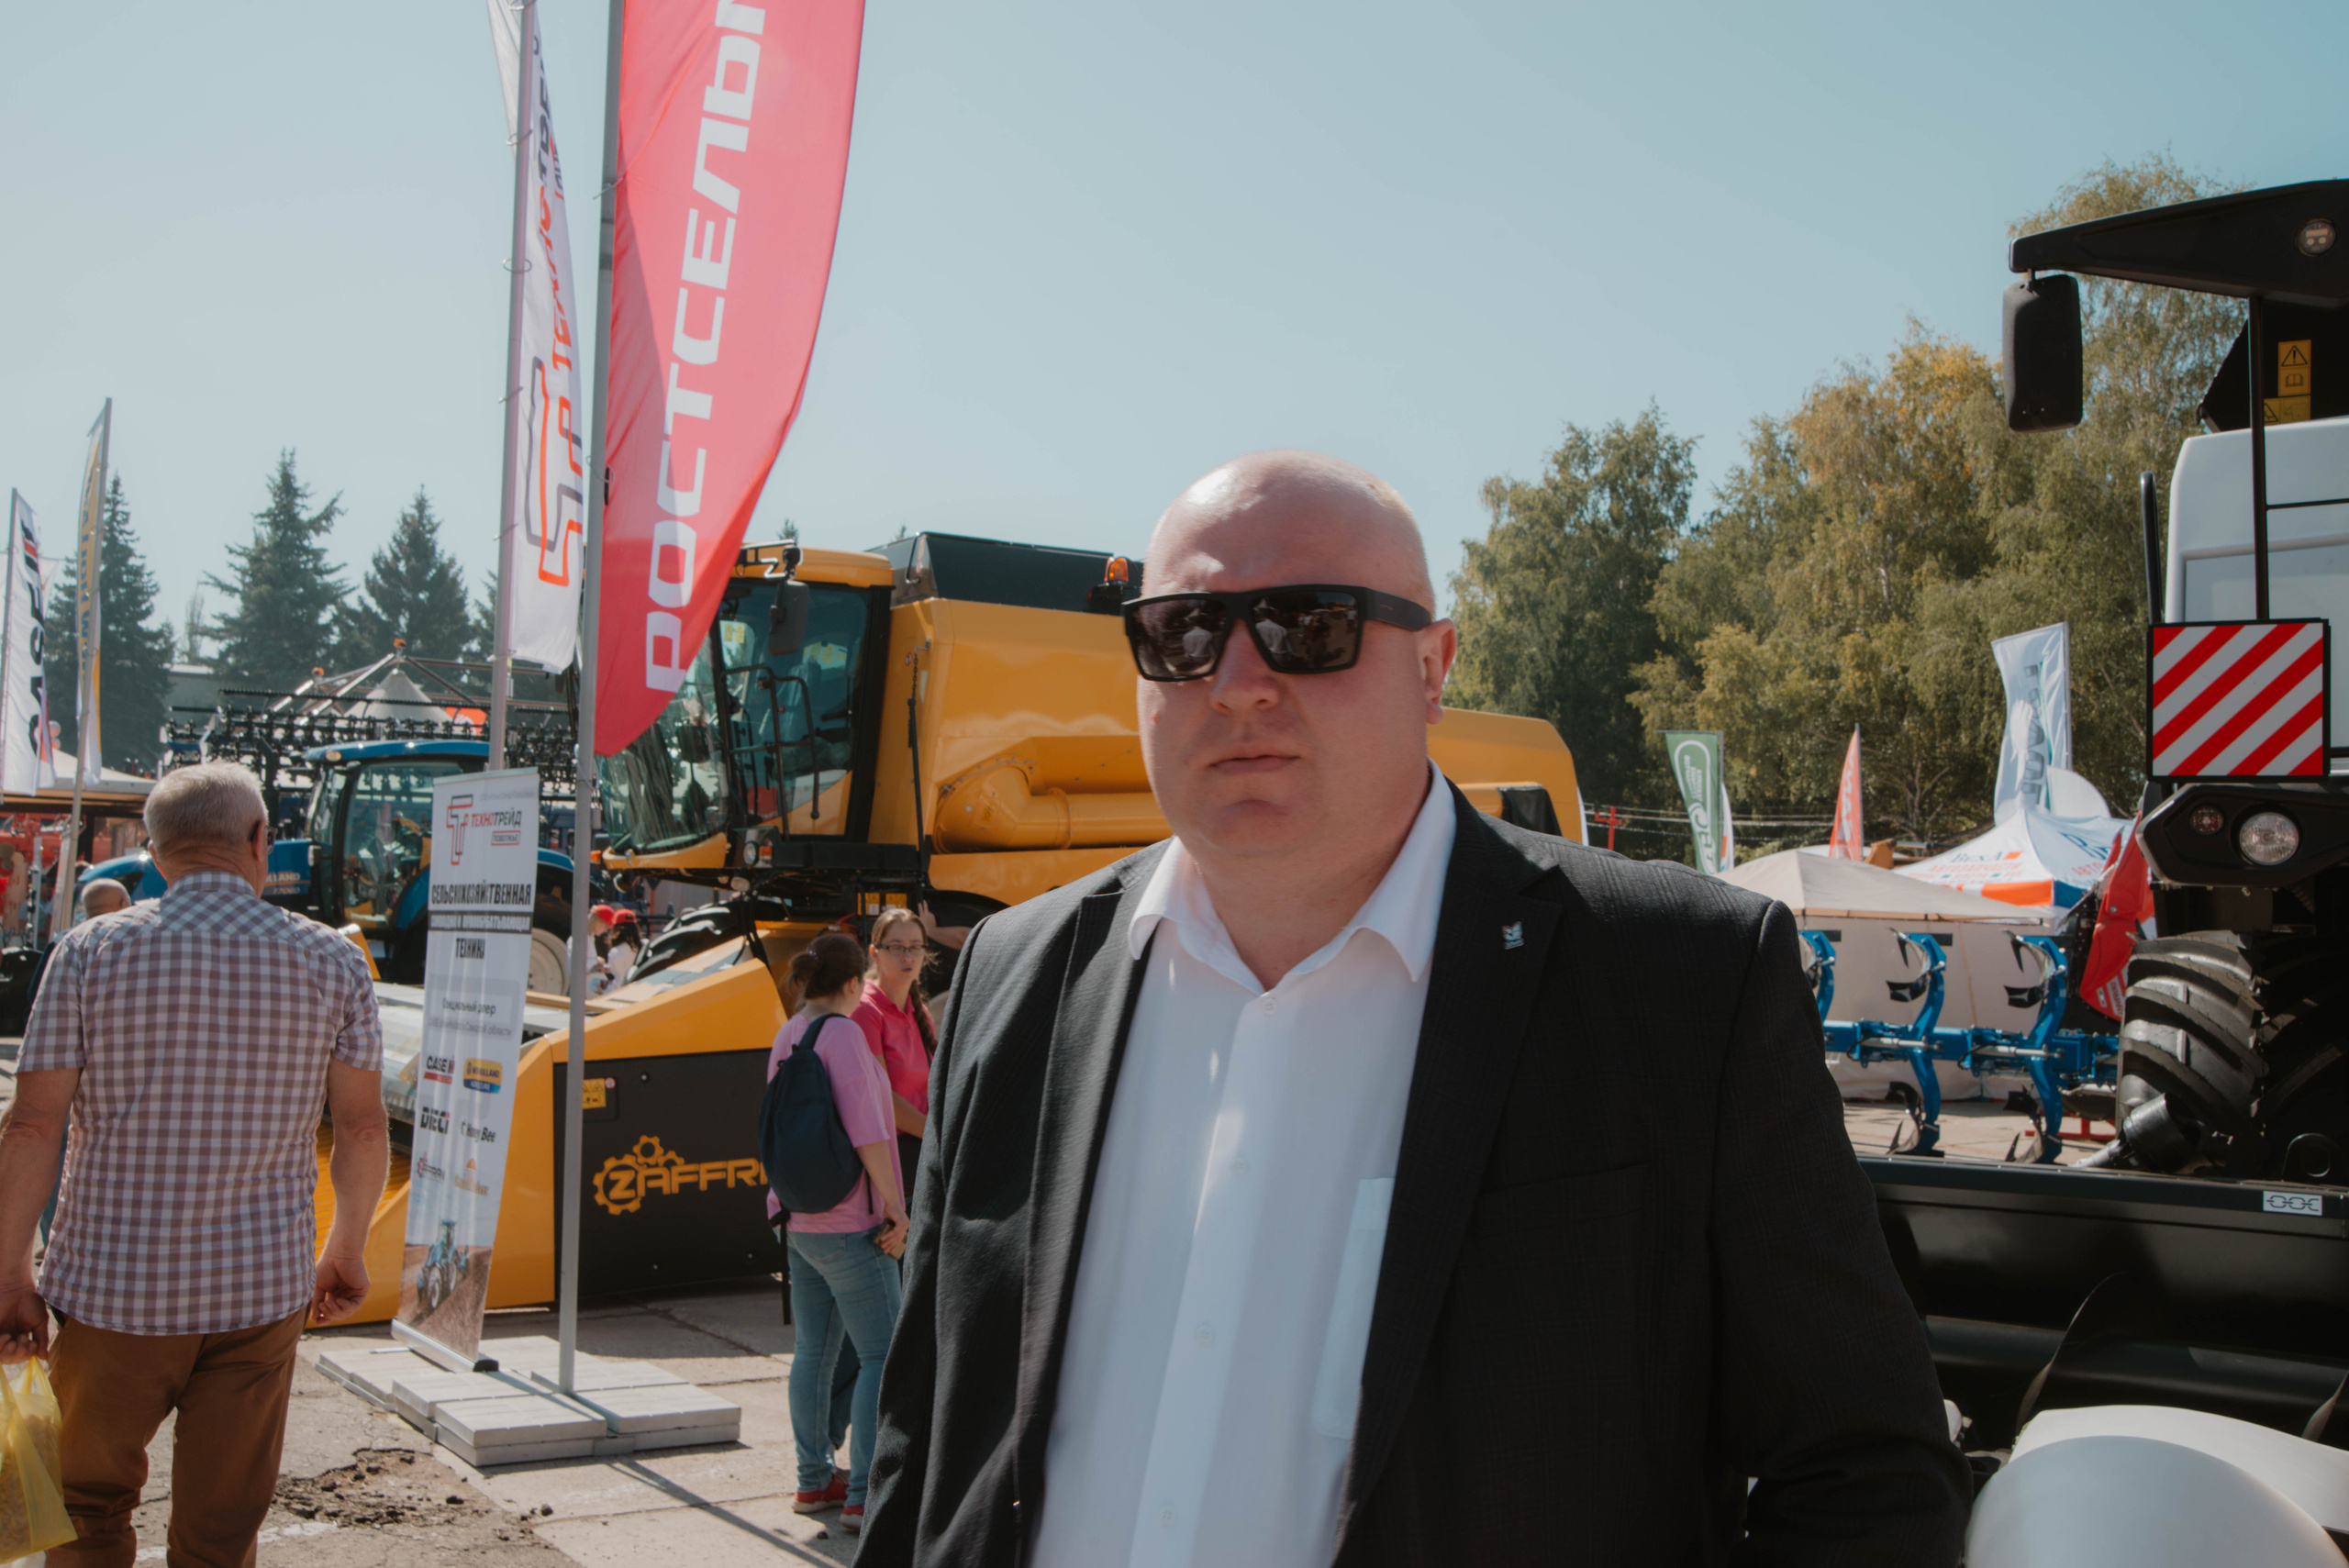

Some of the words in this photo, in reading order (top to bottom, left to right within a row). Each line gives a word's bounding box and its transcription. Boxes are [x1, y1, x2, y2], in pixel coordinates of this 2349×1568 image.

[471, 807, 522, 829] ТЕХНОТРЕЙД
[431, 880, 532, 906] СЕЛЬСКОХОЗЯЙТВЕННАЯ
[426, 1055, 447, 1073] CASE
[481, 1126, 496, 1143] Bee
[608, 1158, 769, 1200] ZAFFR
